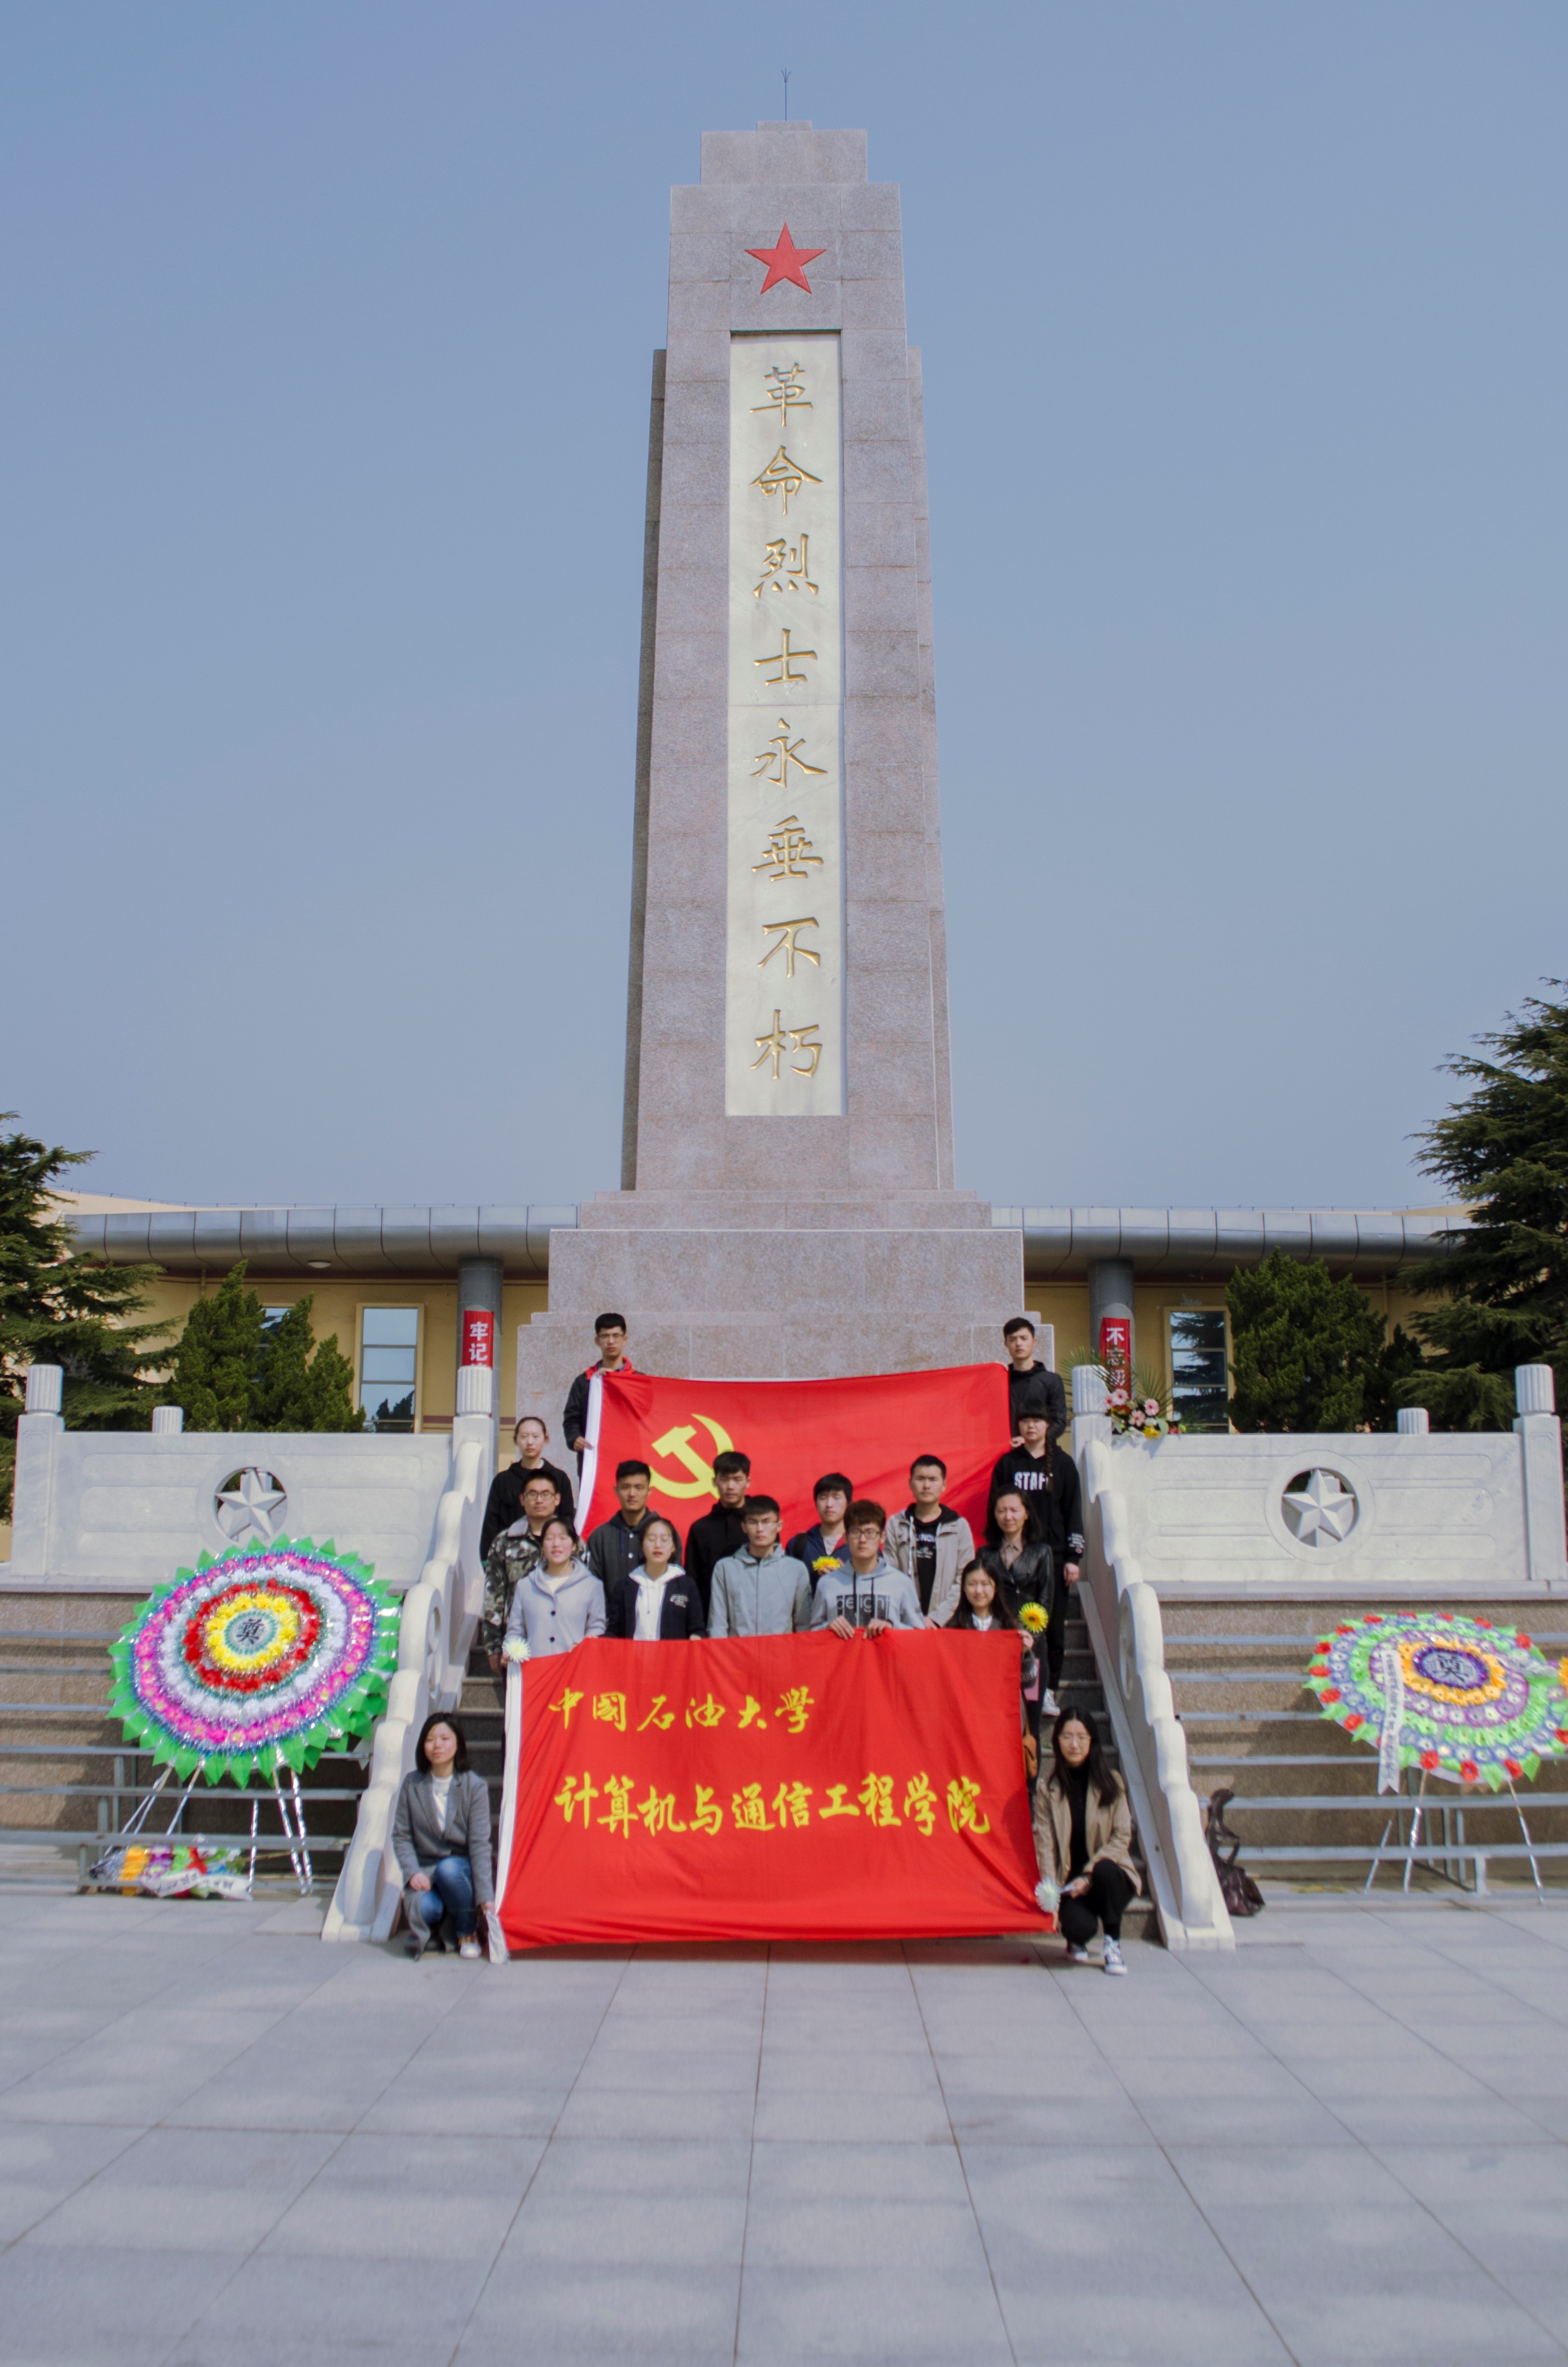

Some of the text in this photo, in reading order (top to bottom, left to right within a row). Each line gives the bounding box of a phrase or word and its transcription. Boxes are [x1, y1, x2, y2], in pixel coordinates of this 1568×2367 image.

[749, 362, 827, 1079] 革命烈士永垂不朽
[468, 1321, 489, 1366] 牢记
[236, 1618, 264, 1644] 奠
[548, 1685, 815, 1734] 中國石油大學
[554, 1771, 991, 1840] 计算机与通信工程学院
